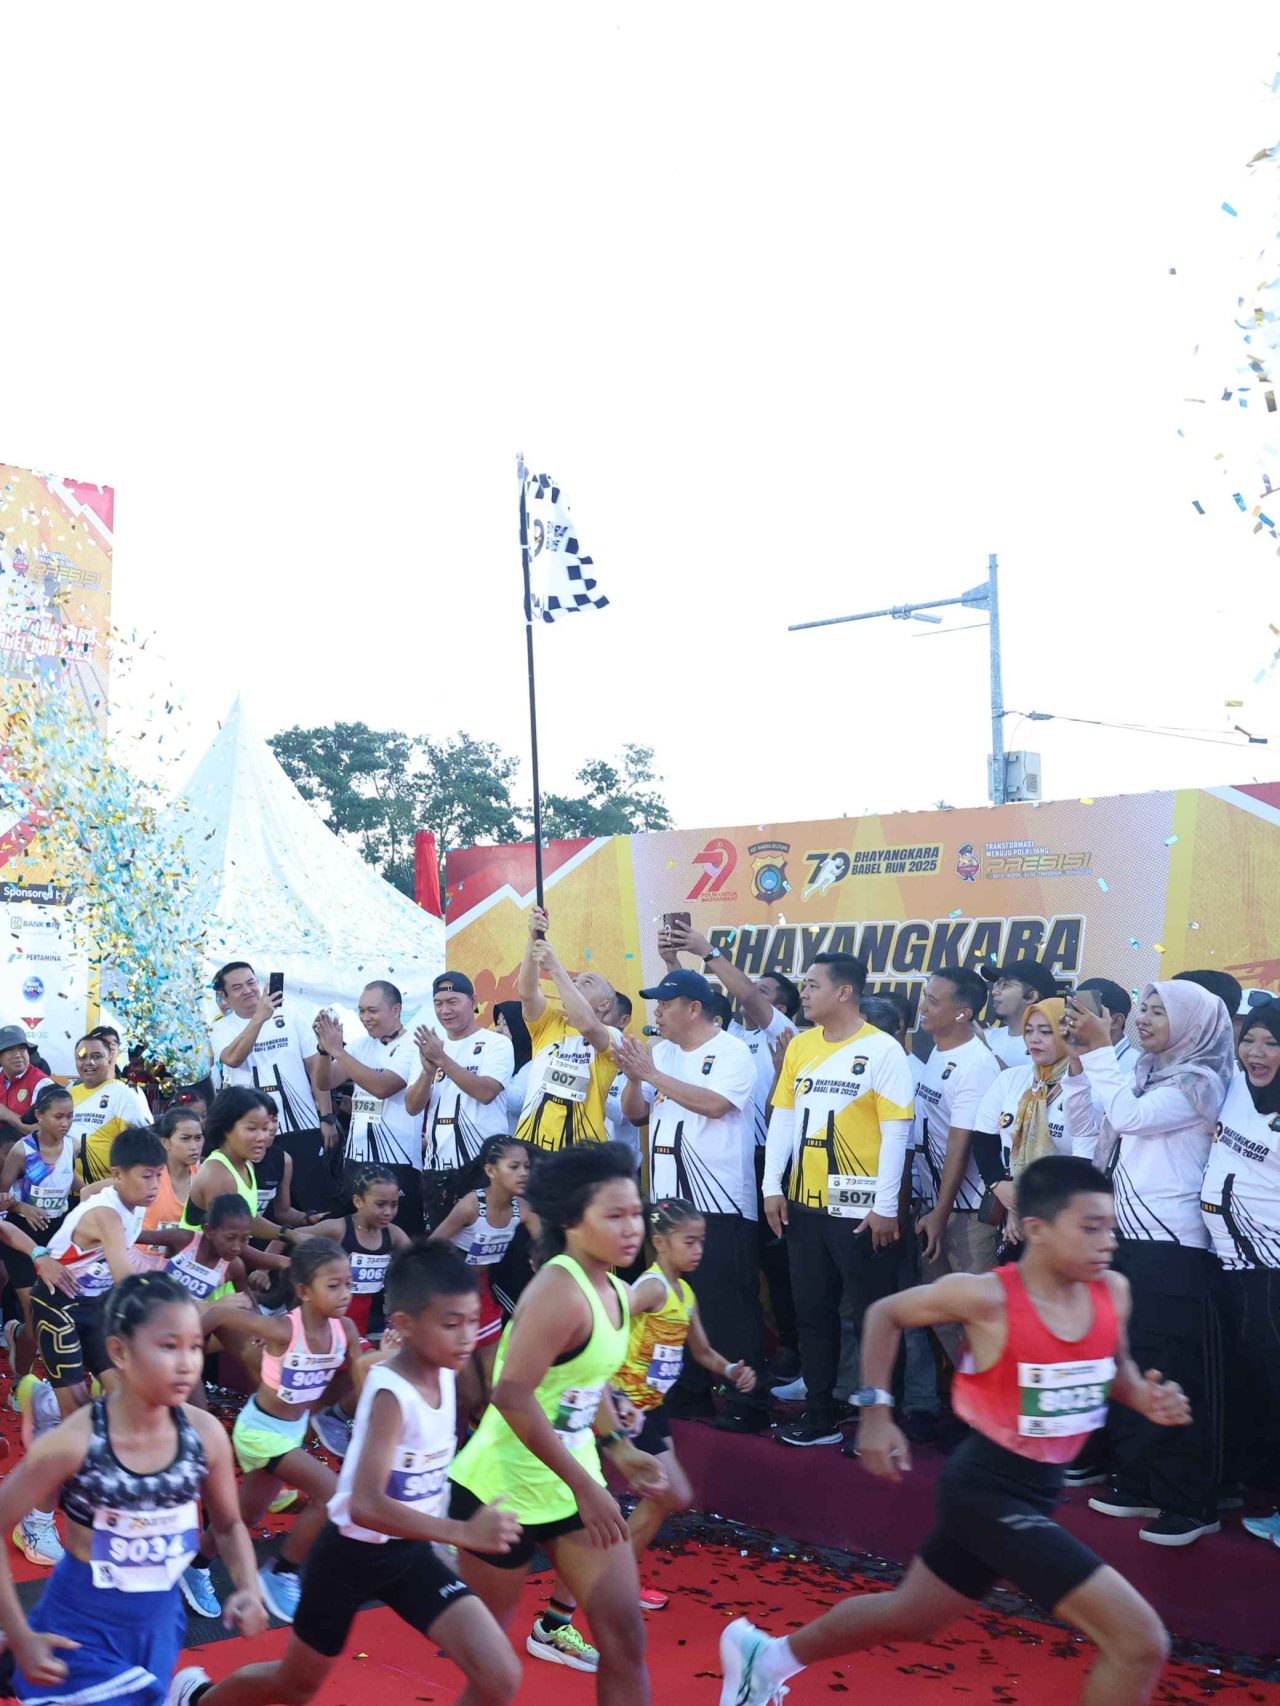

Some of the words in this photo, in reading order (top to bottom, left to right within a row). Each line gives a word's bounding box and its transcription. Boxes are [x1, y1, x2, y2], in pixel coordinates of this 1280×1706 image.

[985, 841, 1034, 850] TRANSFORMASI
[985, 849, 1012, 857] MENUJU
[854, 846, 940, 863] BHAYANGKARA
[851, 863, 884, 876] BABEL
[886, 862, 906, 874] RUN
[908, 860, 937, 872] 2025
[984, 852, 1091, 873] PRESISI
[3, 886, 53, 901] Sponsored
[23, 920, 45, 928] BANK
[706, 918, 1084, 974] BHAYANGKARA
[26, 954, 61, 962] PERTAMINA
[552, 1070, 576, 1086] 007
[815, 1079, 861, 1090] BHAYANGKARA
[813, 1086, 828, 1094] BABEL
[829, 1087, 839, 1095] RUN
[840, 1088, 858, 1097] 2025
[354, 1101, 375, 1111] 5762
[1242, 1148, 1265, 1163] 2025
[839, 1190, 875, 1205] 507
[358, 1268, 385, 1280] 906
[172, 1269, 209, 1296] 9003
[109, 1535, 185, 1562] 9034
